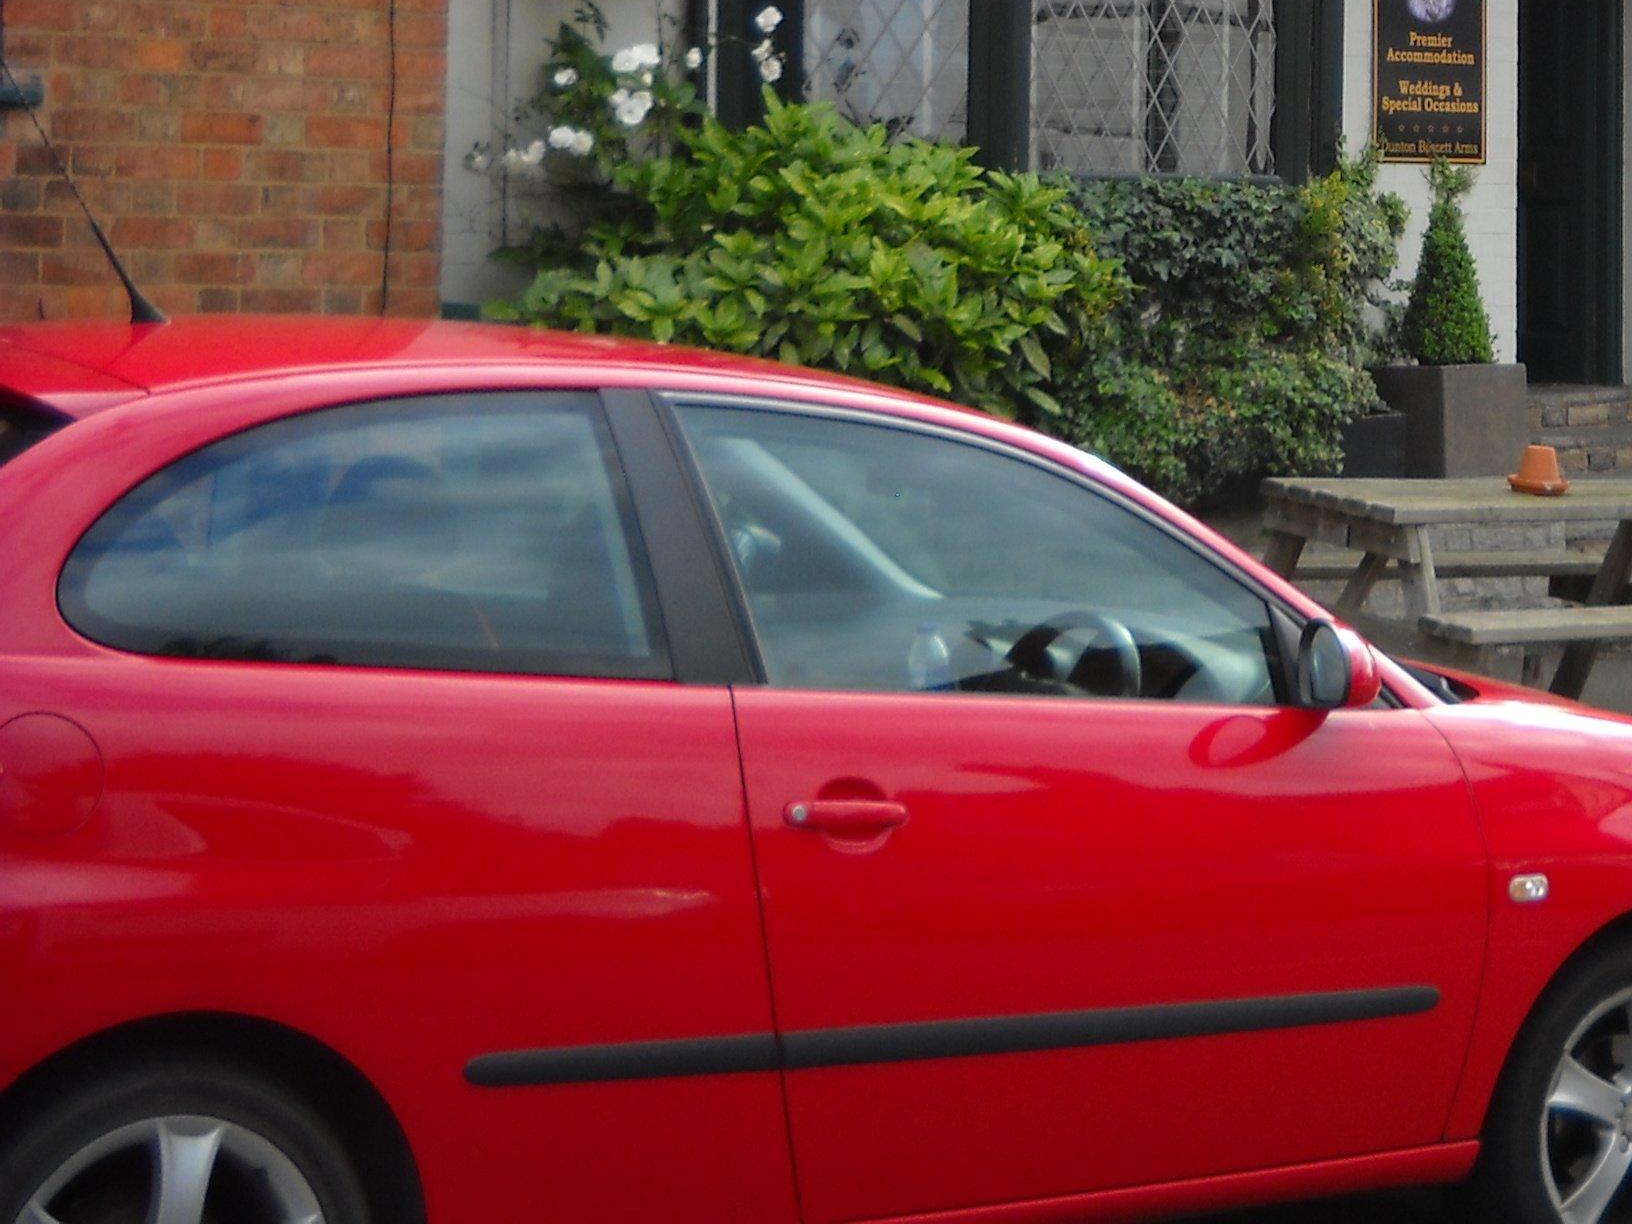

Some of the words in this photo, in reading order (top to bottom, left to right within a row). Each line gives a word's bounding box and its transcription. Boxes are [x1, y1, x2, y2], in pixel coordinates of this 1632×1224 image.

[1408, 31, 1453, 47] Premier
[1386, 47, 1475, 65] Accommodation
[1398, 79, 1451, 99] Weddings
[1453, 82, 1463, 97] &
[1382, 96, 1421, 114] Special
[1424, 97, 1479, 113] Occasions
